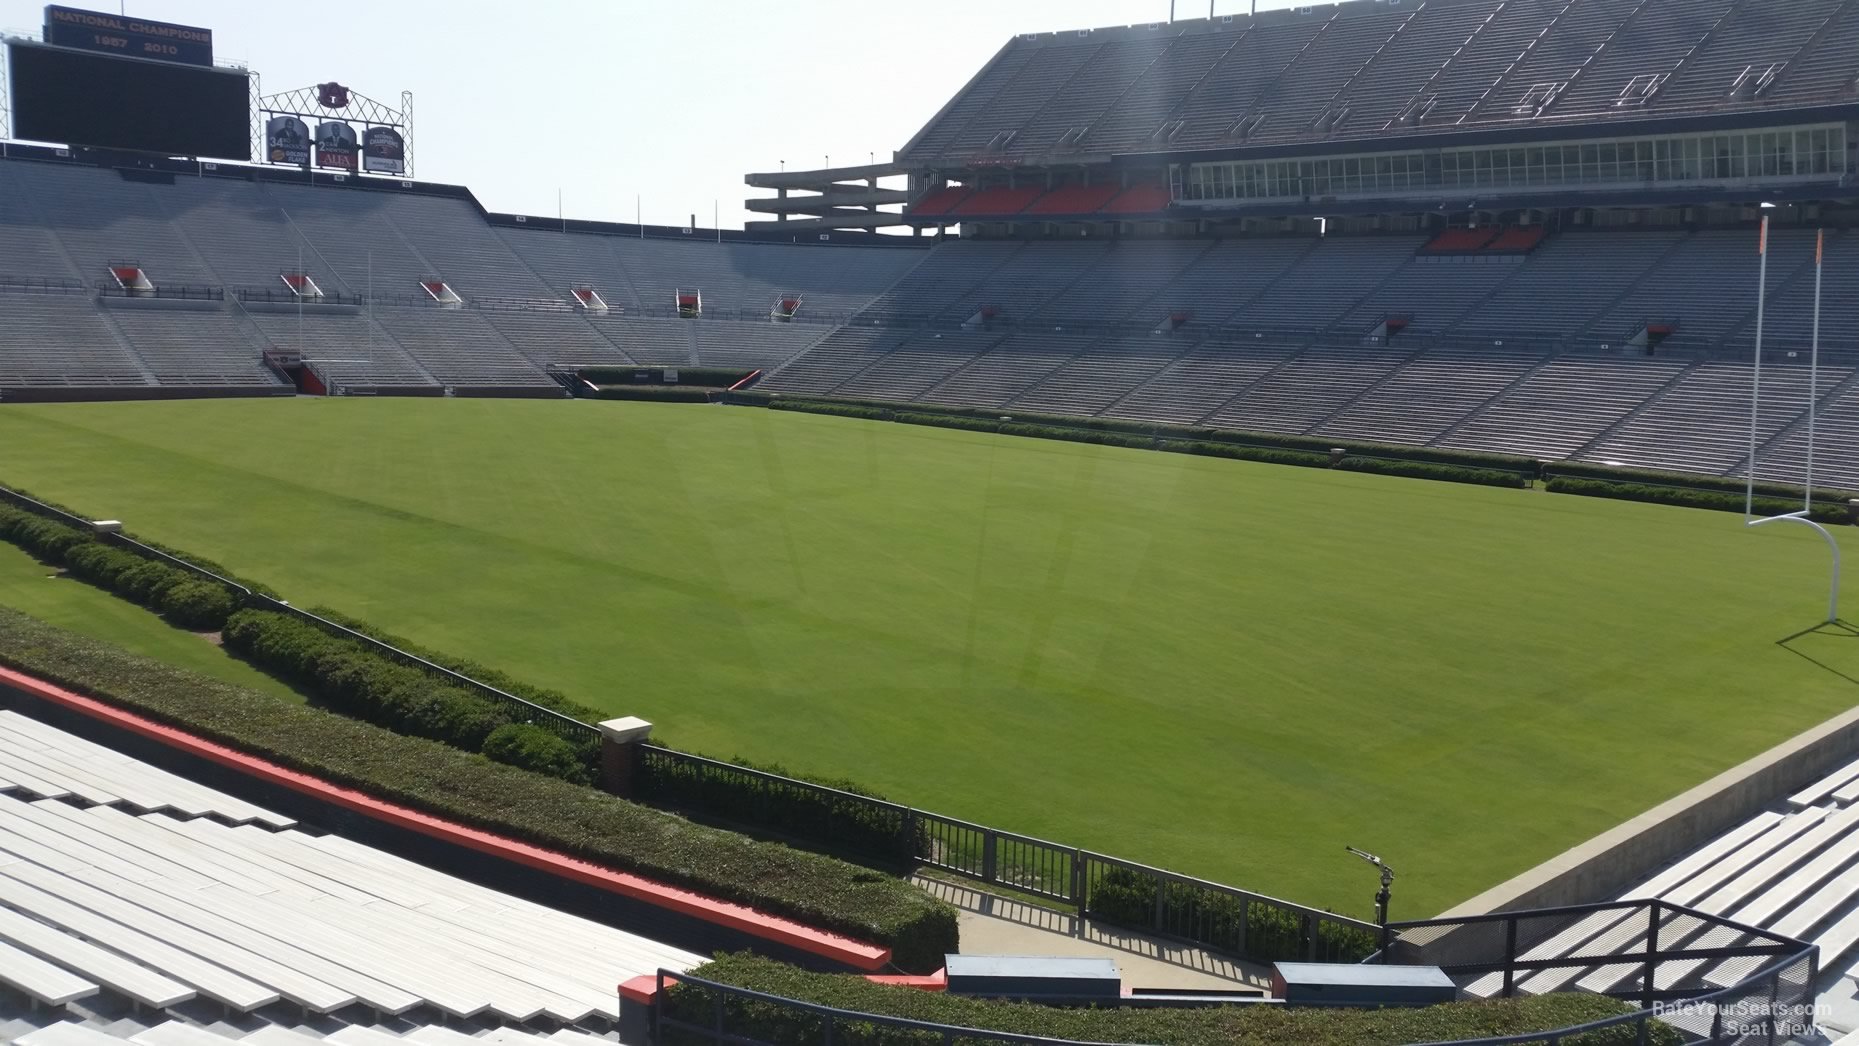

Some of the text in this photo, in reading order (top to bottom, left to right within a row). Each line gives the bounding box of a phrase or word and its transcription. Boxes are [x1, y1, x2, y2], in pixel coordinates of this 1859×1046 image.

[53, 10, 209, 42] NATIONAL CHAMPIONS
[94, 34, 178, 54] 1957 2010
[270, 136, 283, 147] 34
[318, 141, 325, 151] 2
